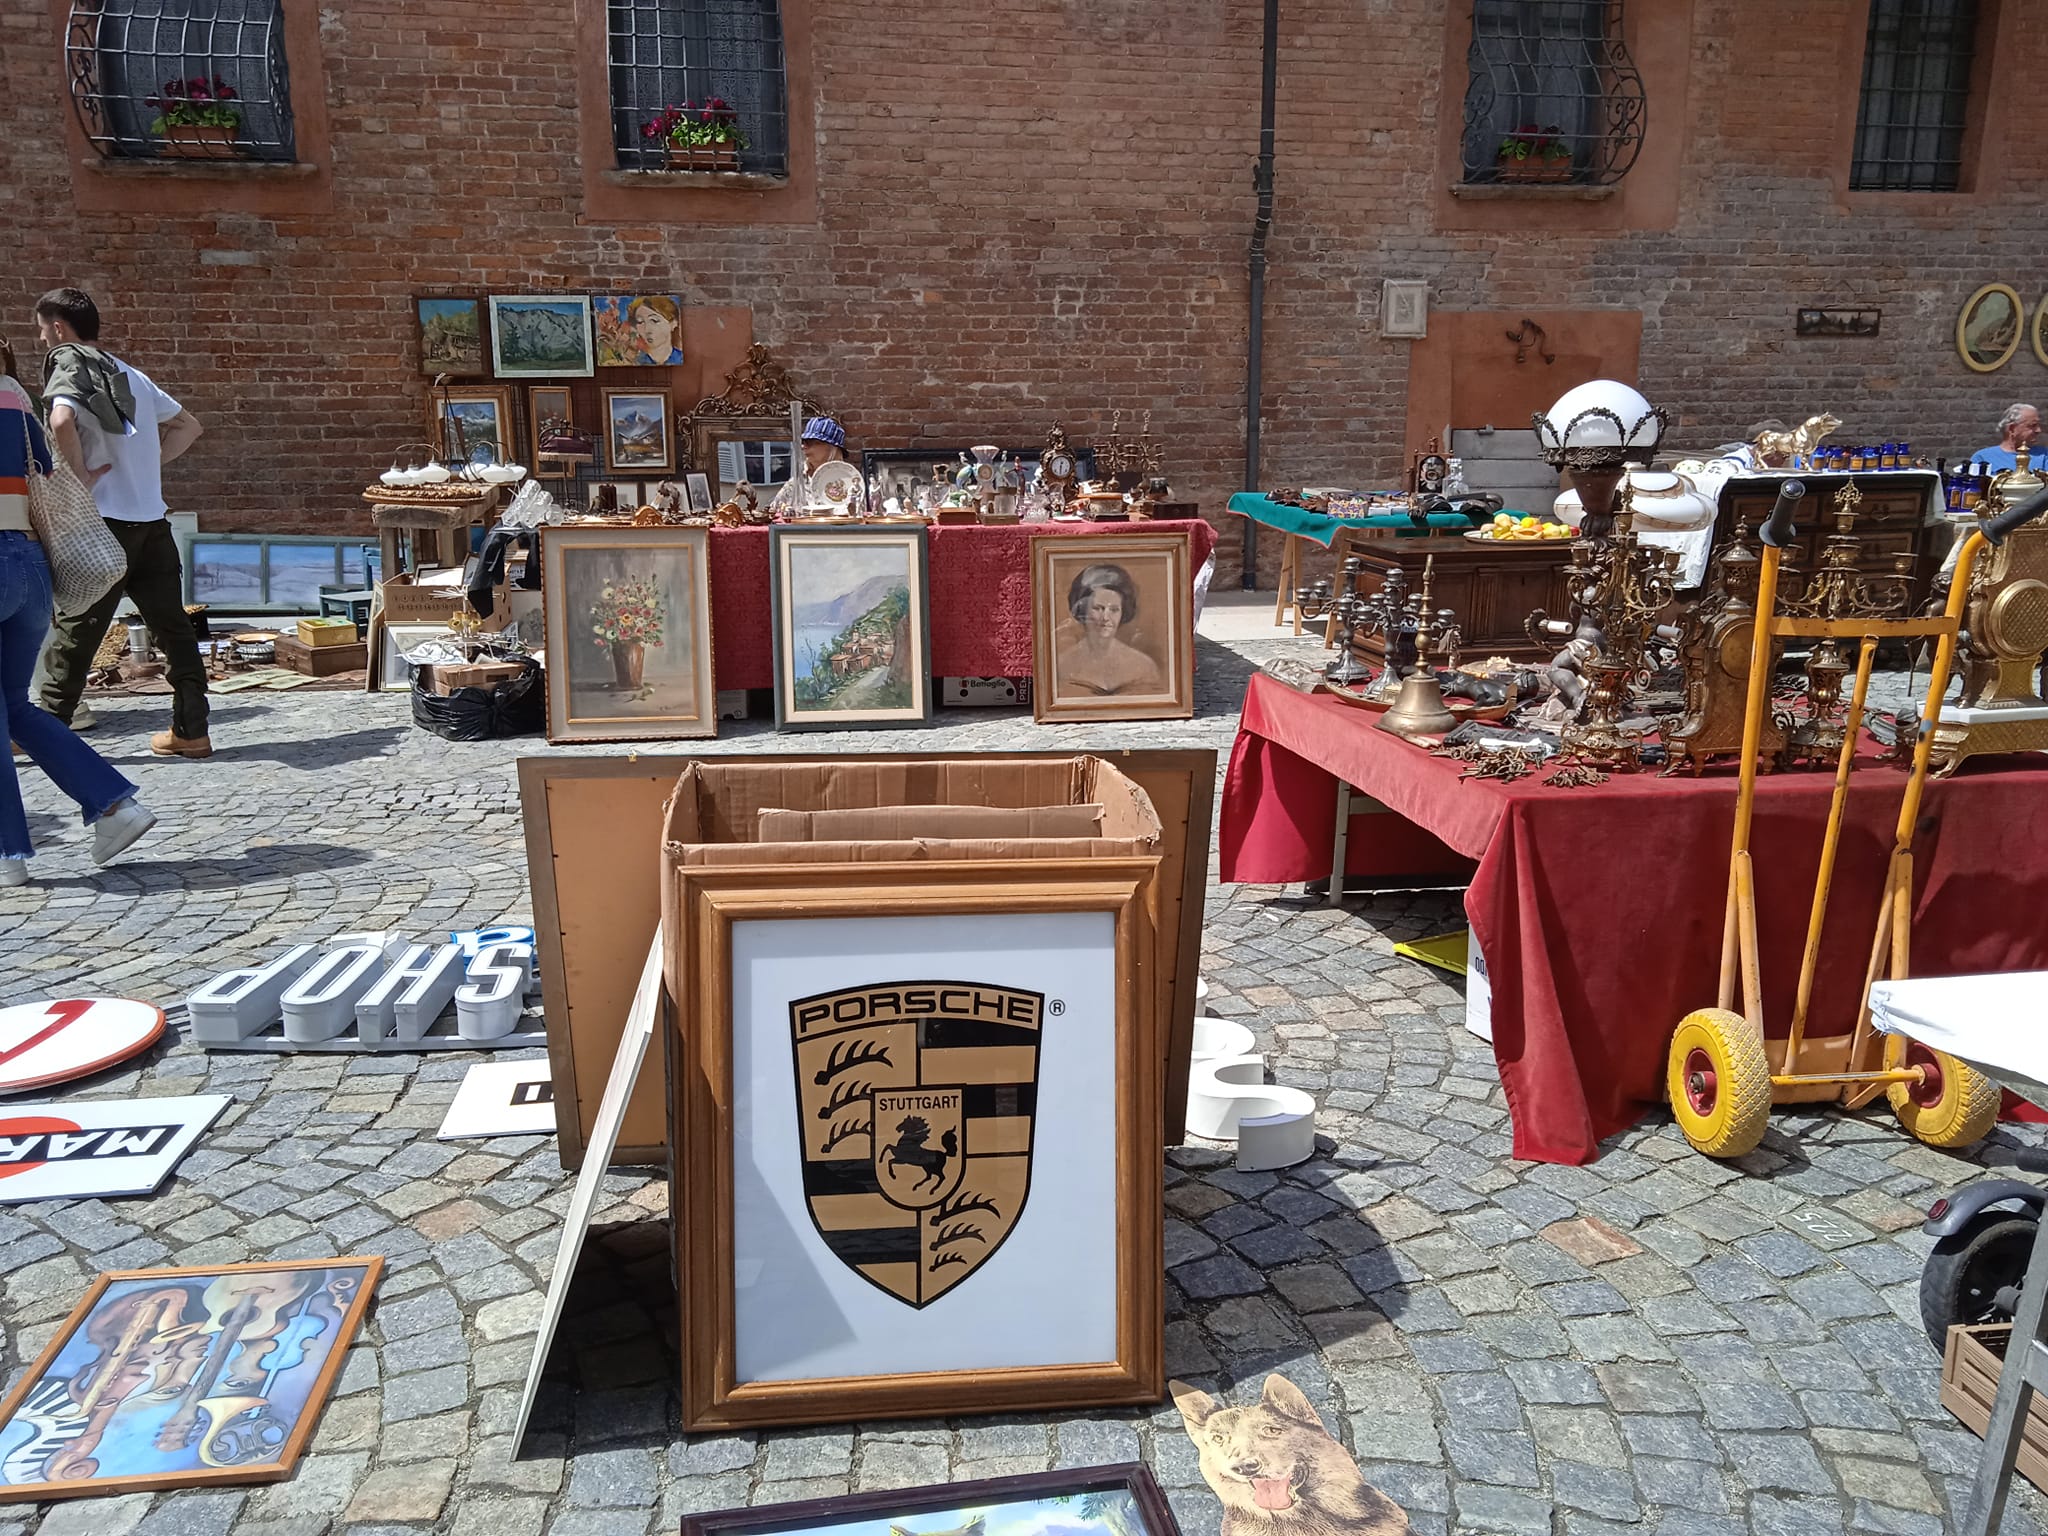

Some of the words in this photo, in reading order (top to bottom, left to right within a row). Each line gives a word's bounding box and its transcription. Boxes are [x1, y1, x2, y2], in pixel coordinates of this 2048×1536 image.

[186, 942, 534, 1007] SHOP
[799, 989, 1035, 1034] PORSCHE
[878, 1094, 960, 1112] STUTTGART
[0, 1126, 167, 1163] MAR
